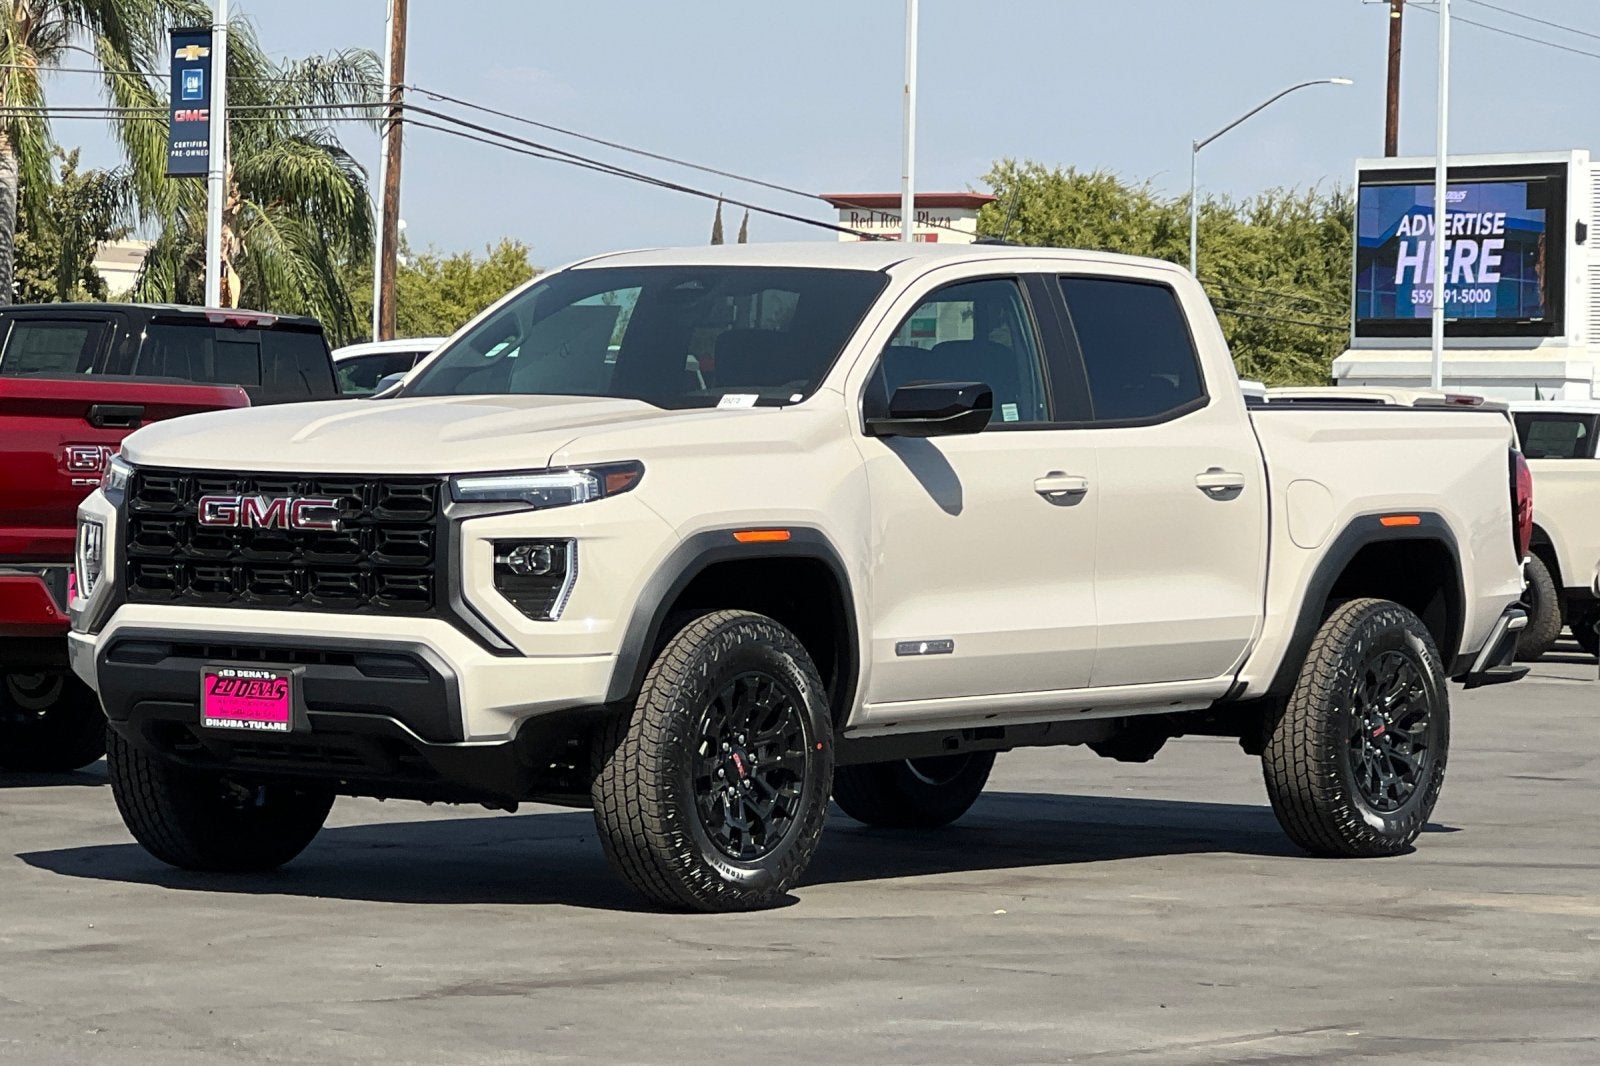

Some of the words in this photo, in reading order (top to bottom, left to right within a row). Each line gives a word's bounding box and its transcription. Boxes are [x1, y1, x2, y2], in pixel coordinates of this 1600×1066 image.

[174, 109, 209, 122] GMC
[173, 140, 208, 148] CERTIFIED
[170, 149, 209, 157] PRE-OWNED
[850, 211, 873, 229] Red
[880, 212, 903, 229] Roc
[916, 211, 951, 229] Plaza
[1395, 239, 1505, 284] HERE
[1411, 289, 1491, 304] 55991-5000
[198, 495, 339, 531] GMC
[223, 669, 235, 677] ED
[237, 670, 270, 679] DENA'S
[210, 678, 236, 696] ED
[248, 721, 287, 731] TULARE
